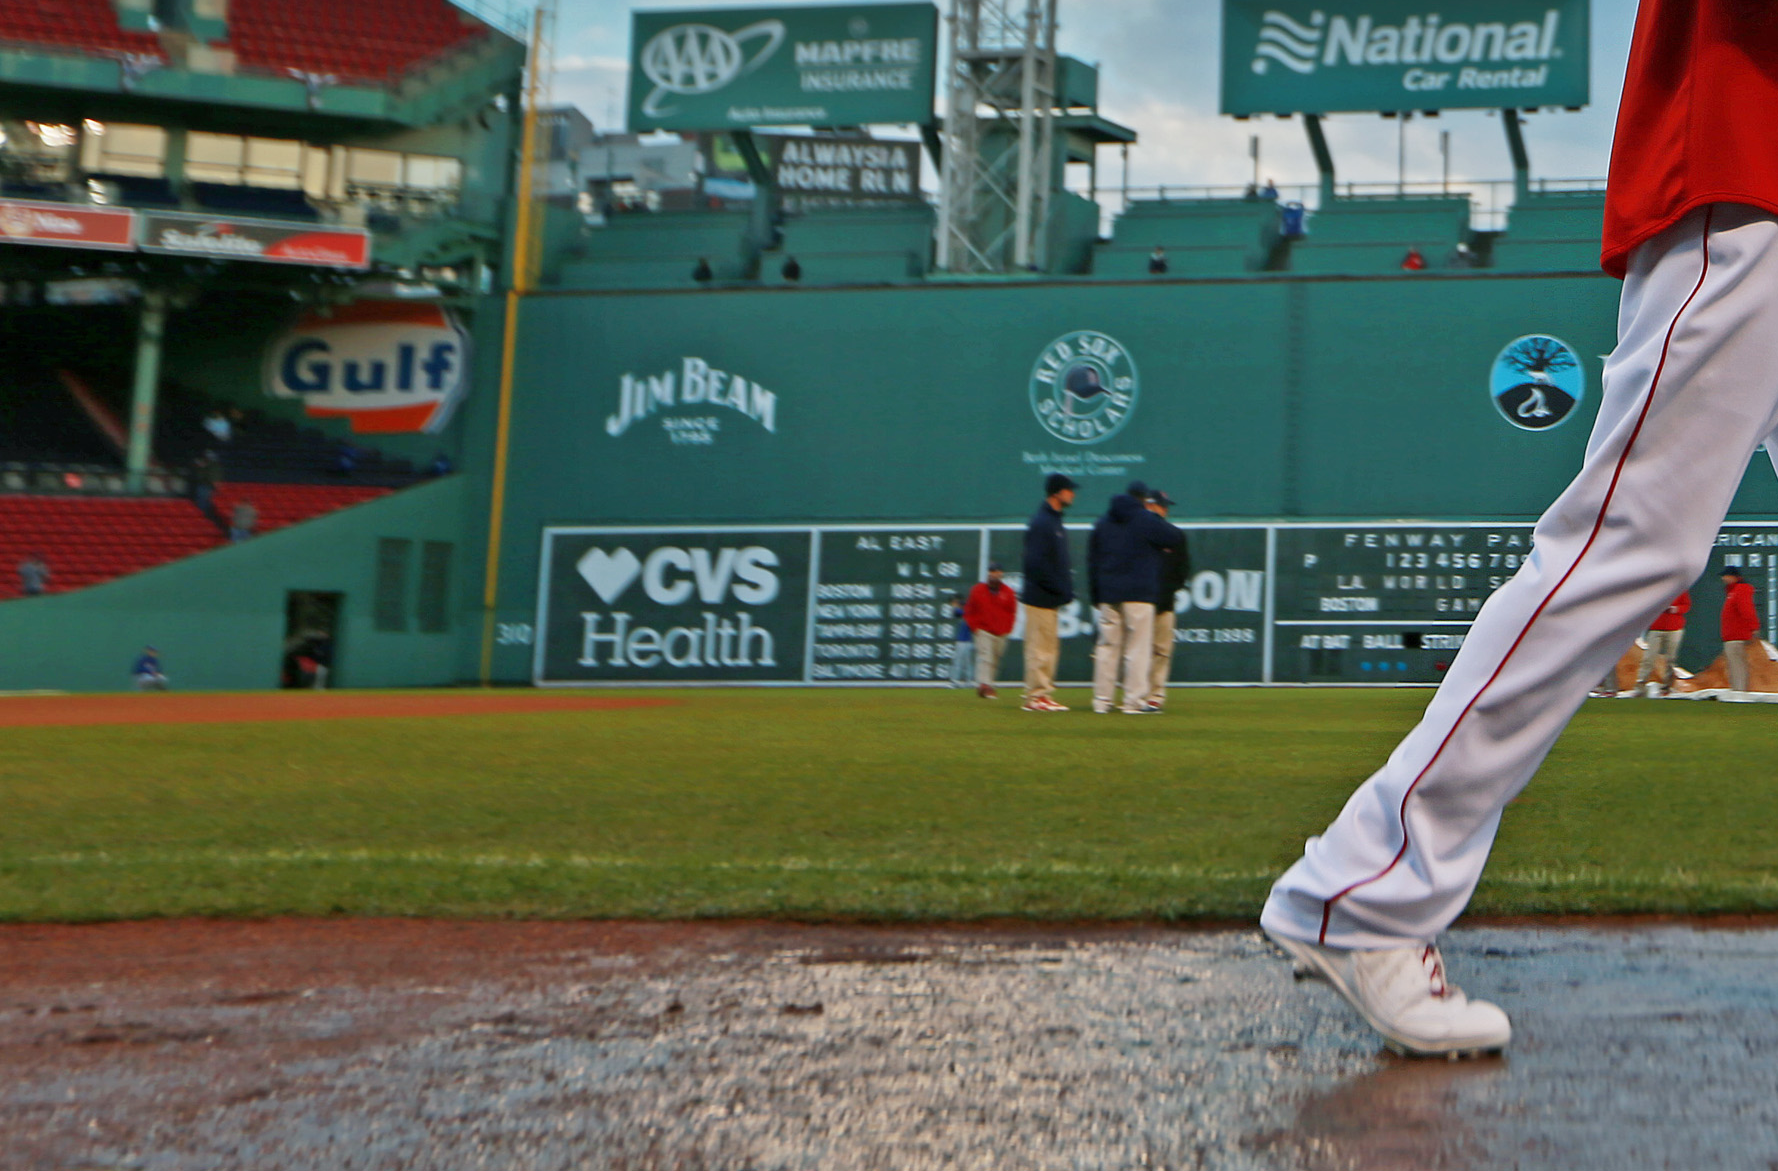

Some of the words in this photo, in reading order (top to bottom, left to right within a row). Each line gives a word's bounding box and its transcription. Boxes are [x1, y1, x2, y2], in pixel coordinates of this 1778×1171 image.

[1322, 9, 1560, 66] National
[651, 28, 730, 89] AAA
[795, 38, 921, 65] MAPFRE
[800, 69, 915, 92] INSURANCE
[1402, 68, 1450, 91] Car
[1457, 65, 1548, 90] Rental
[778, 164, 852, 192] HOME
[279, 341, 456, 395] Gulf
[1036, 341, 1075, 384] RED
[1078, 335, 1122, 365] SOX
[890, 536, 945, 551] EAST
[1344, 534, 1465, 548] FENWAY
[1304, 553, 1318, 568] P
[642, 546, 782, 606] CVS
[1320, 597, 1379, 612] BOSTON
[1436, 598, 1480, 612] GAM
[577, 612, 777, 668] Health
[1363, 634, 1404, 649] BALL
